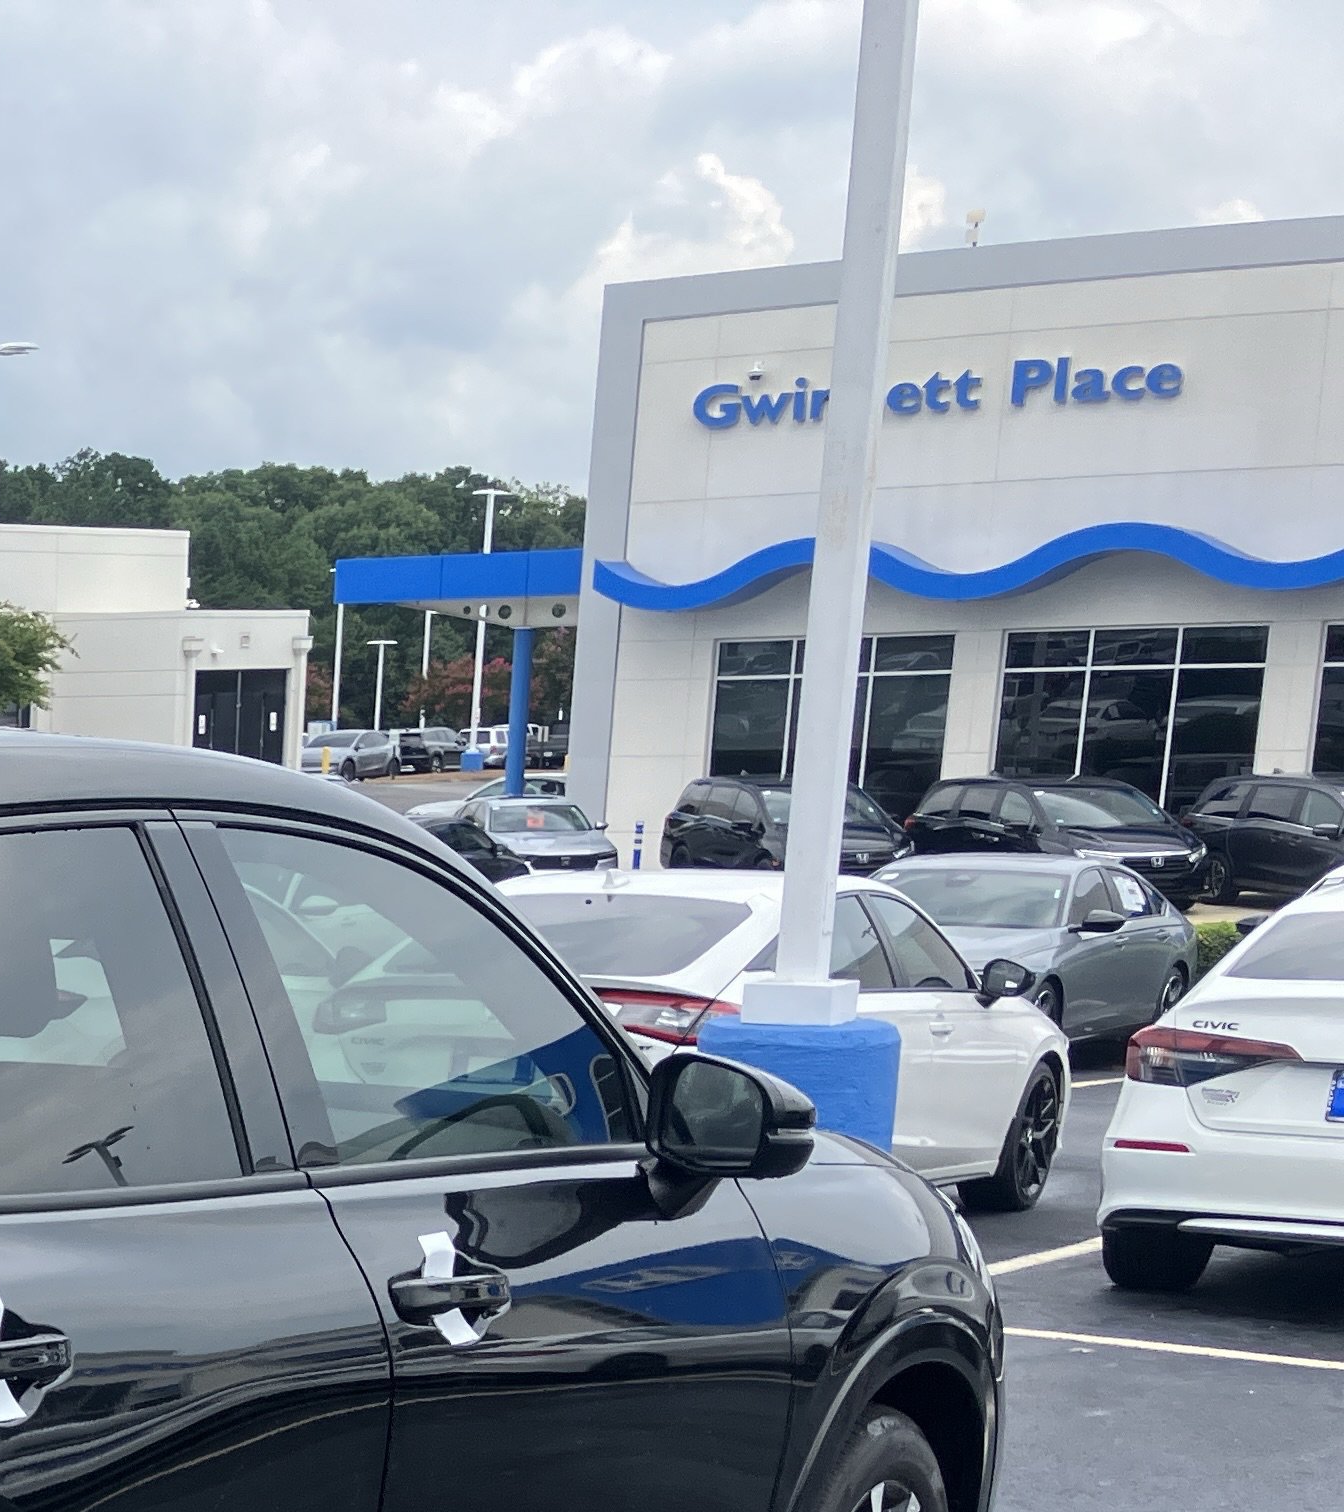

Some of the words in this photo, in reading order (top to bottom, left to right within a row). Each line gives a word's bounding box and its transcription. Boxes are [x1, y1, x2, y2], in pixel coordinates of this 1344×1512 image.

[692, 368, 983, 429] Gwiett
[1013, 357, 1185, 408] Place
[1192, 1019, 1240, 1031] CIVIC
